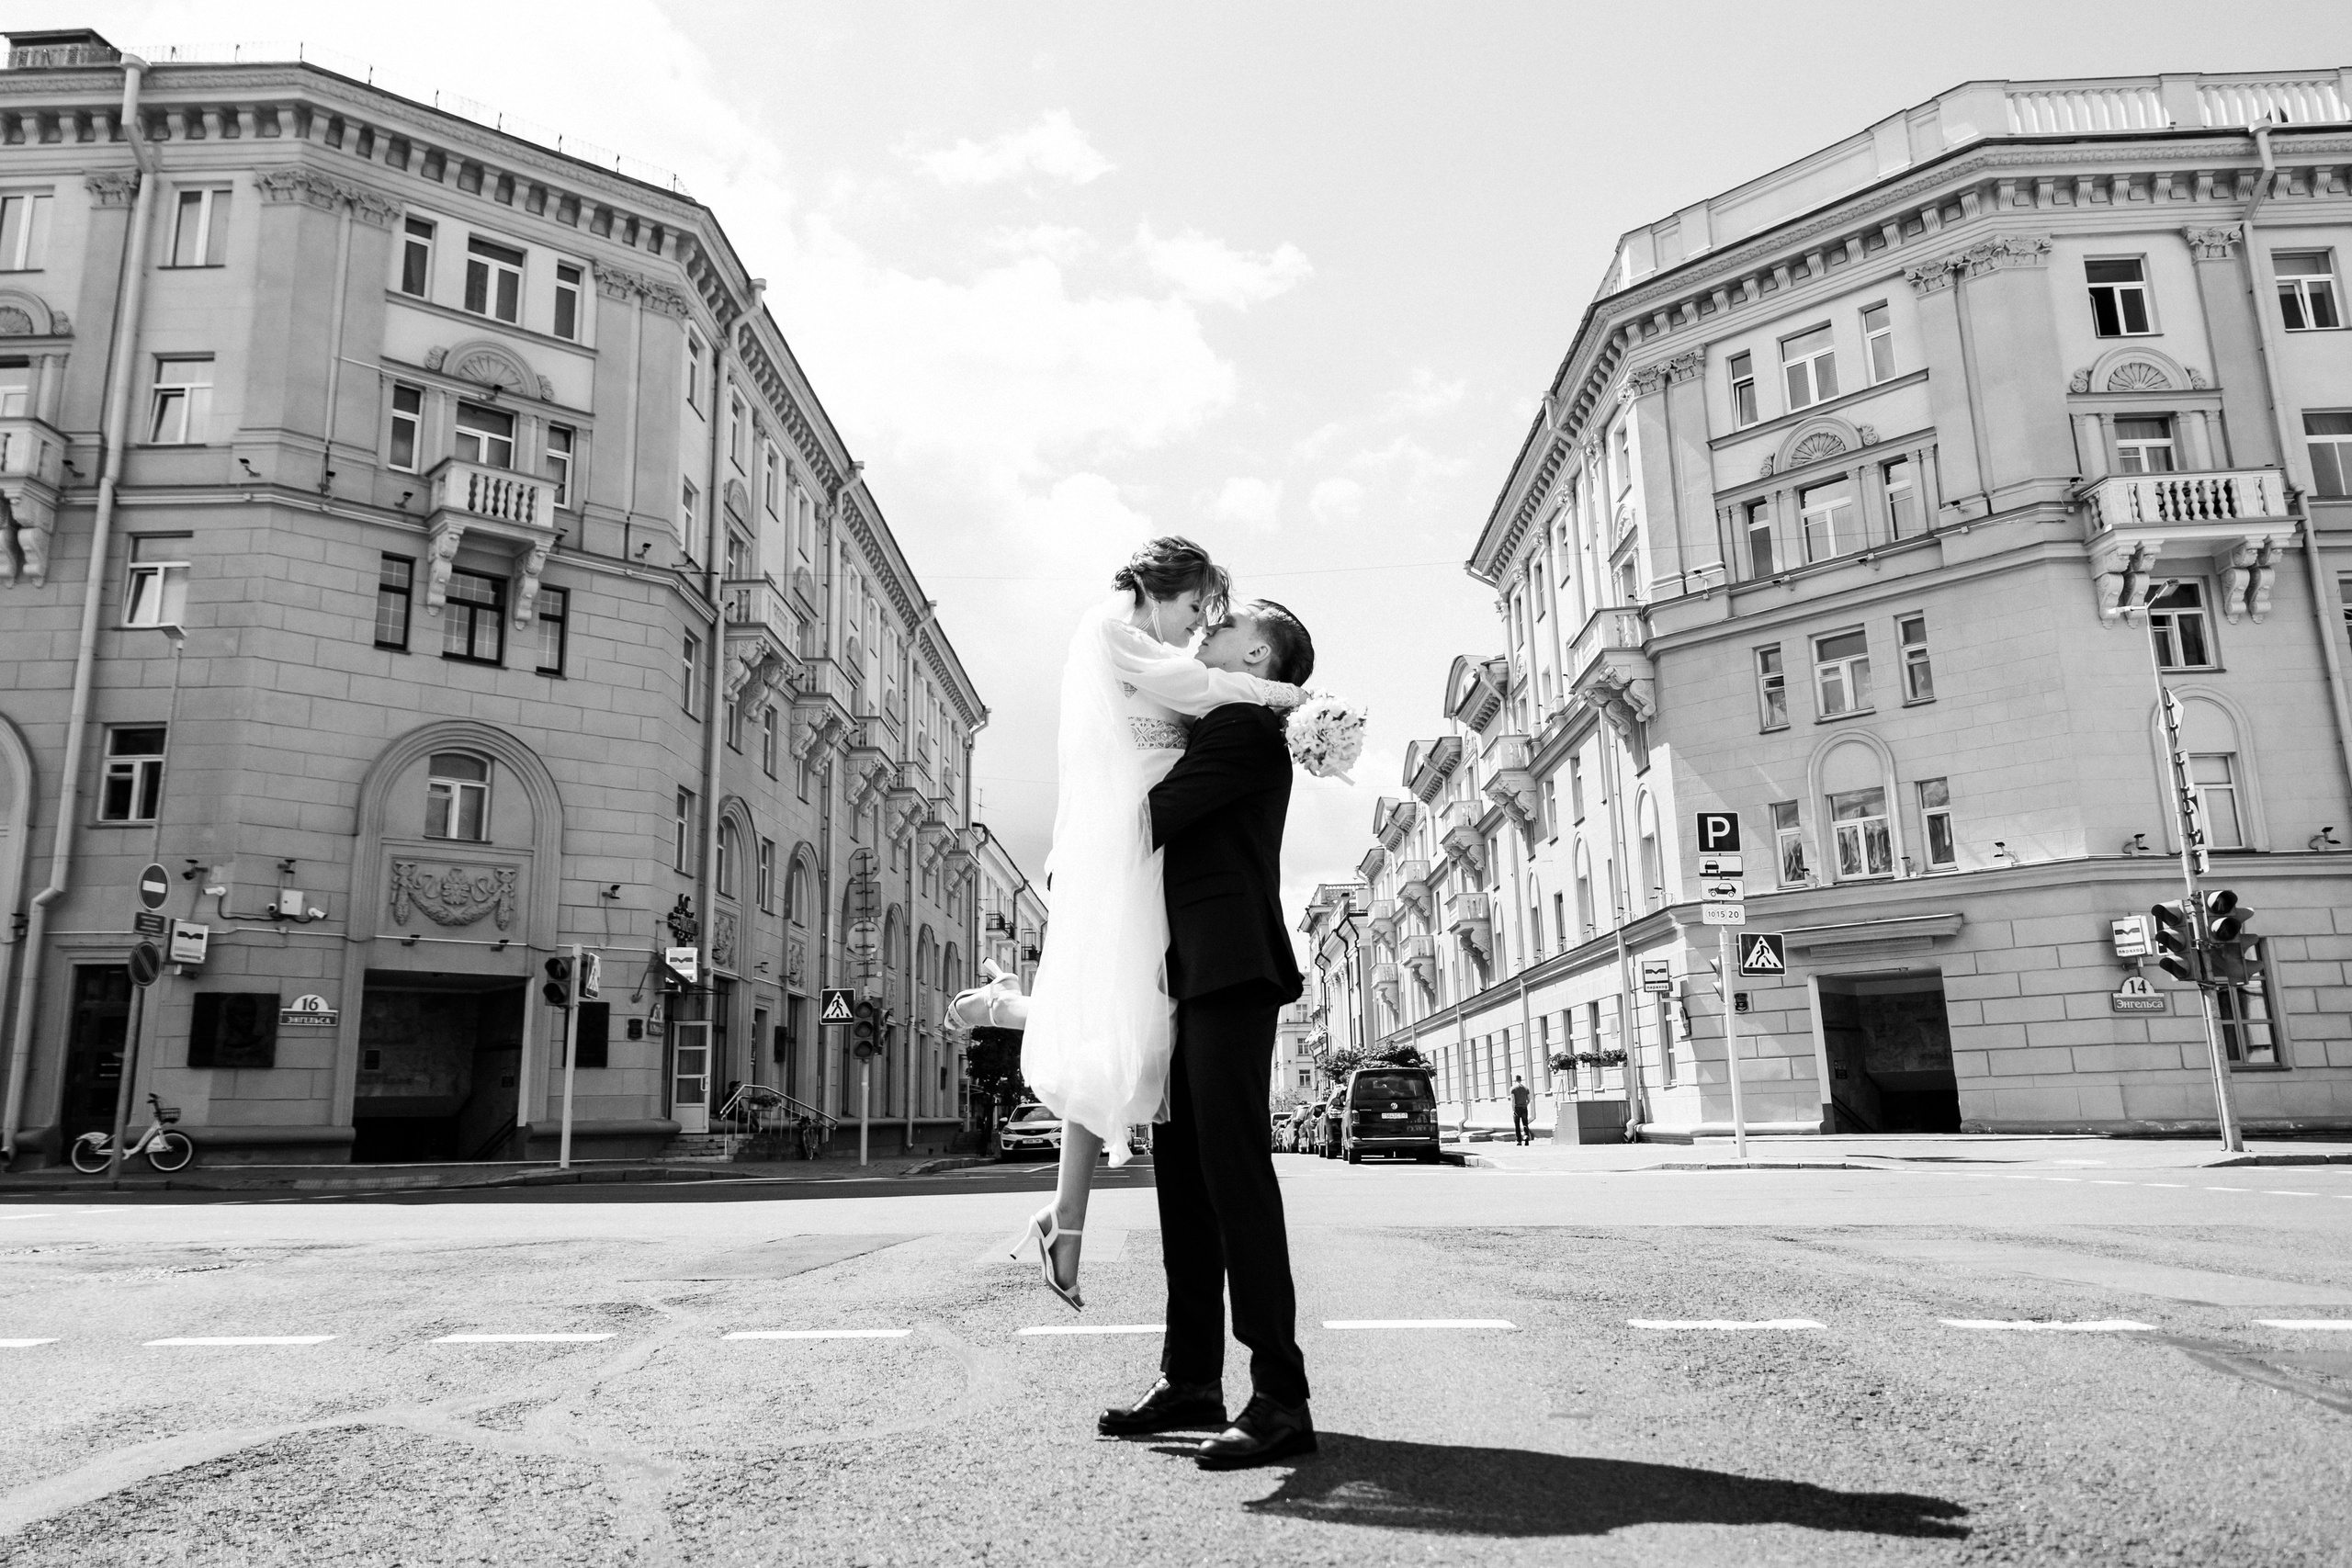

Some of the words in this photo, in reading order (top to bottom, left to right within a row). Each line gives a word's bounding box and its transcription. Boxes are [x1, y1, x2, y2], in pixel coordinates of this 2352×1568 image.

[1707, 817, 1730, 848] P
[1728, 910, 1739, 919] 20
[2129, 980, 2146, 994] 14
[302, 997, 318, 1010] 16
[2116, 999, 2164, 1009] Энгельса
